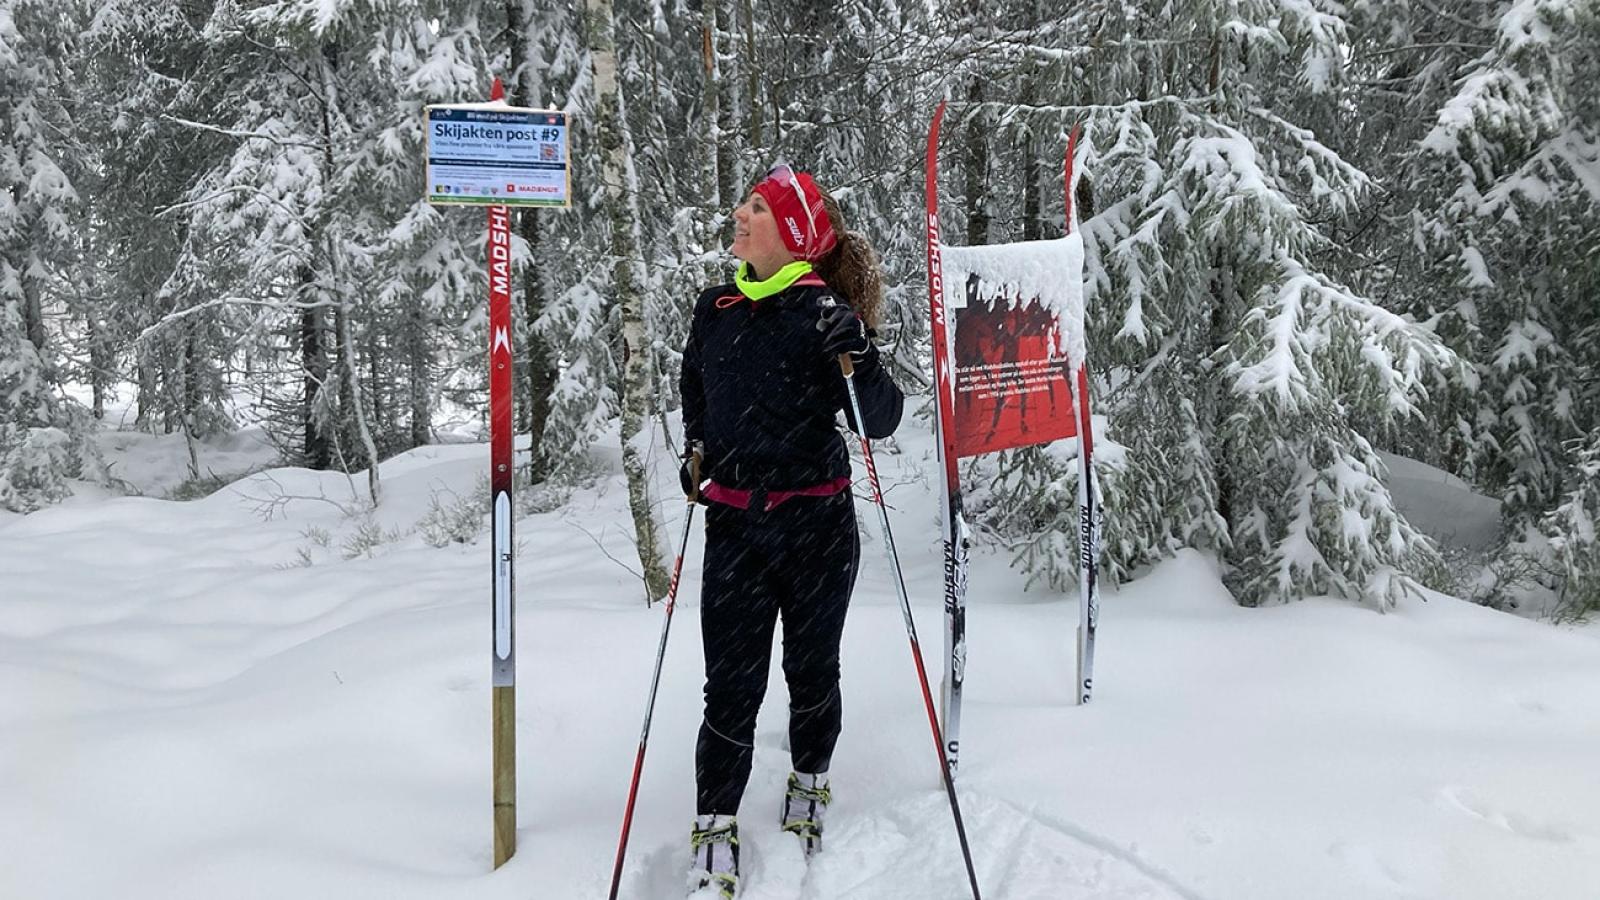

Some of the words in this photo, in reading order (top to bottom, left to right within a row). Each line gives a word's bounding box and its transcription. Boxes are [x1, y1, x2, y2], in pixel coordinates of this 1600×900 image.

[435, 123, 503, 140] Skijakten
[506, 128, 537, 142] post
[541, 128, 560, 142] #9
[492, 204, 508, 295] MADSHU
[929, 213, 945, 325] MADSHUS
[1081, 505, 1089, 570] MADSHUS
[943, 540, 953, 615] MADSHUS
